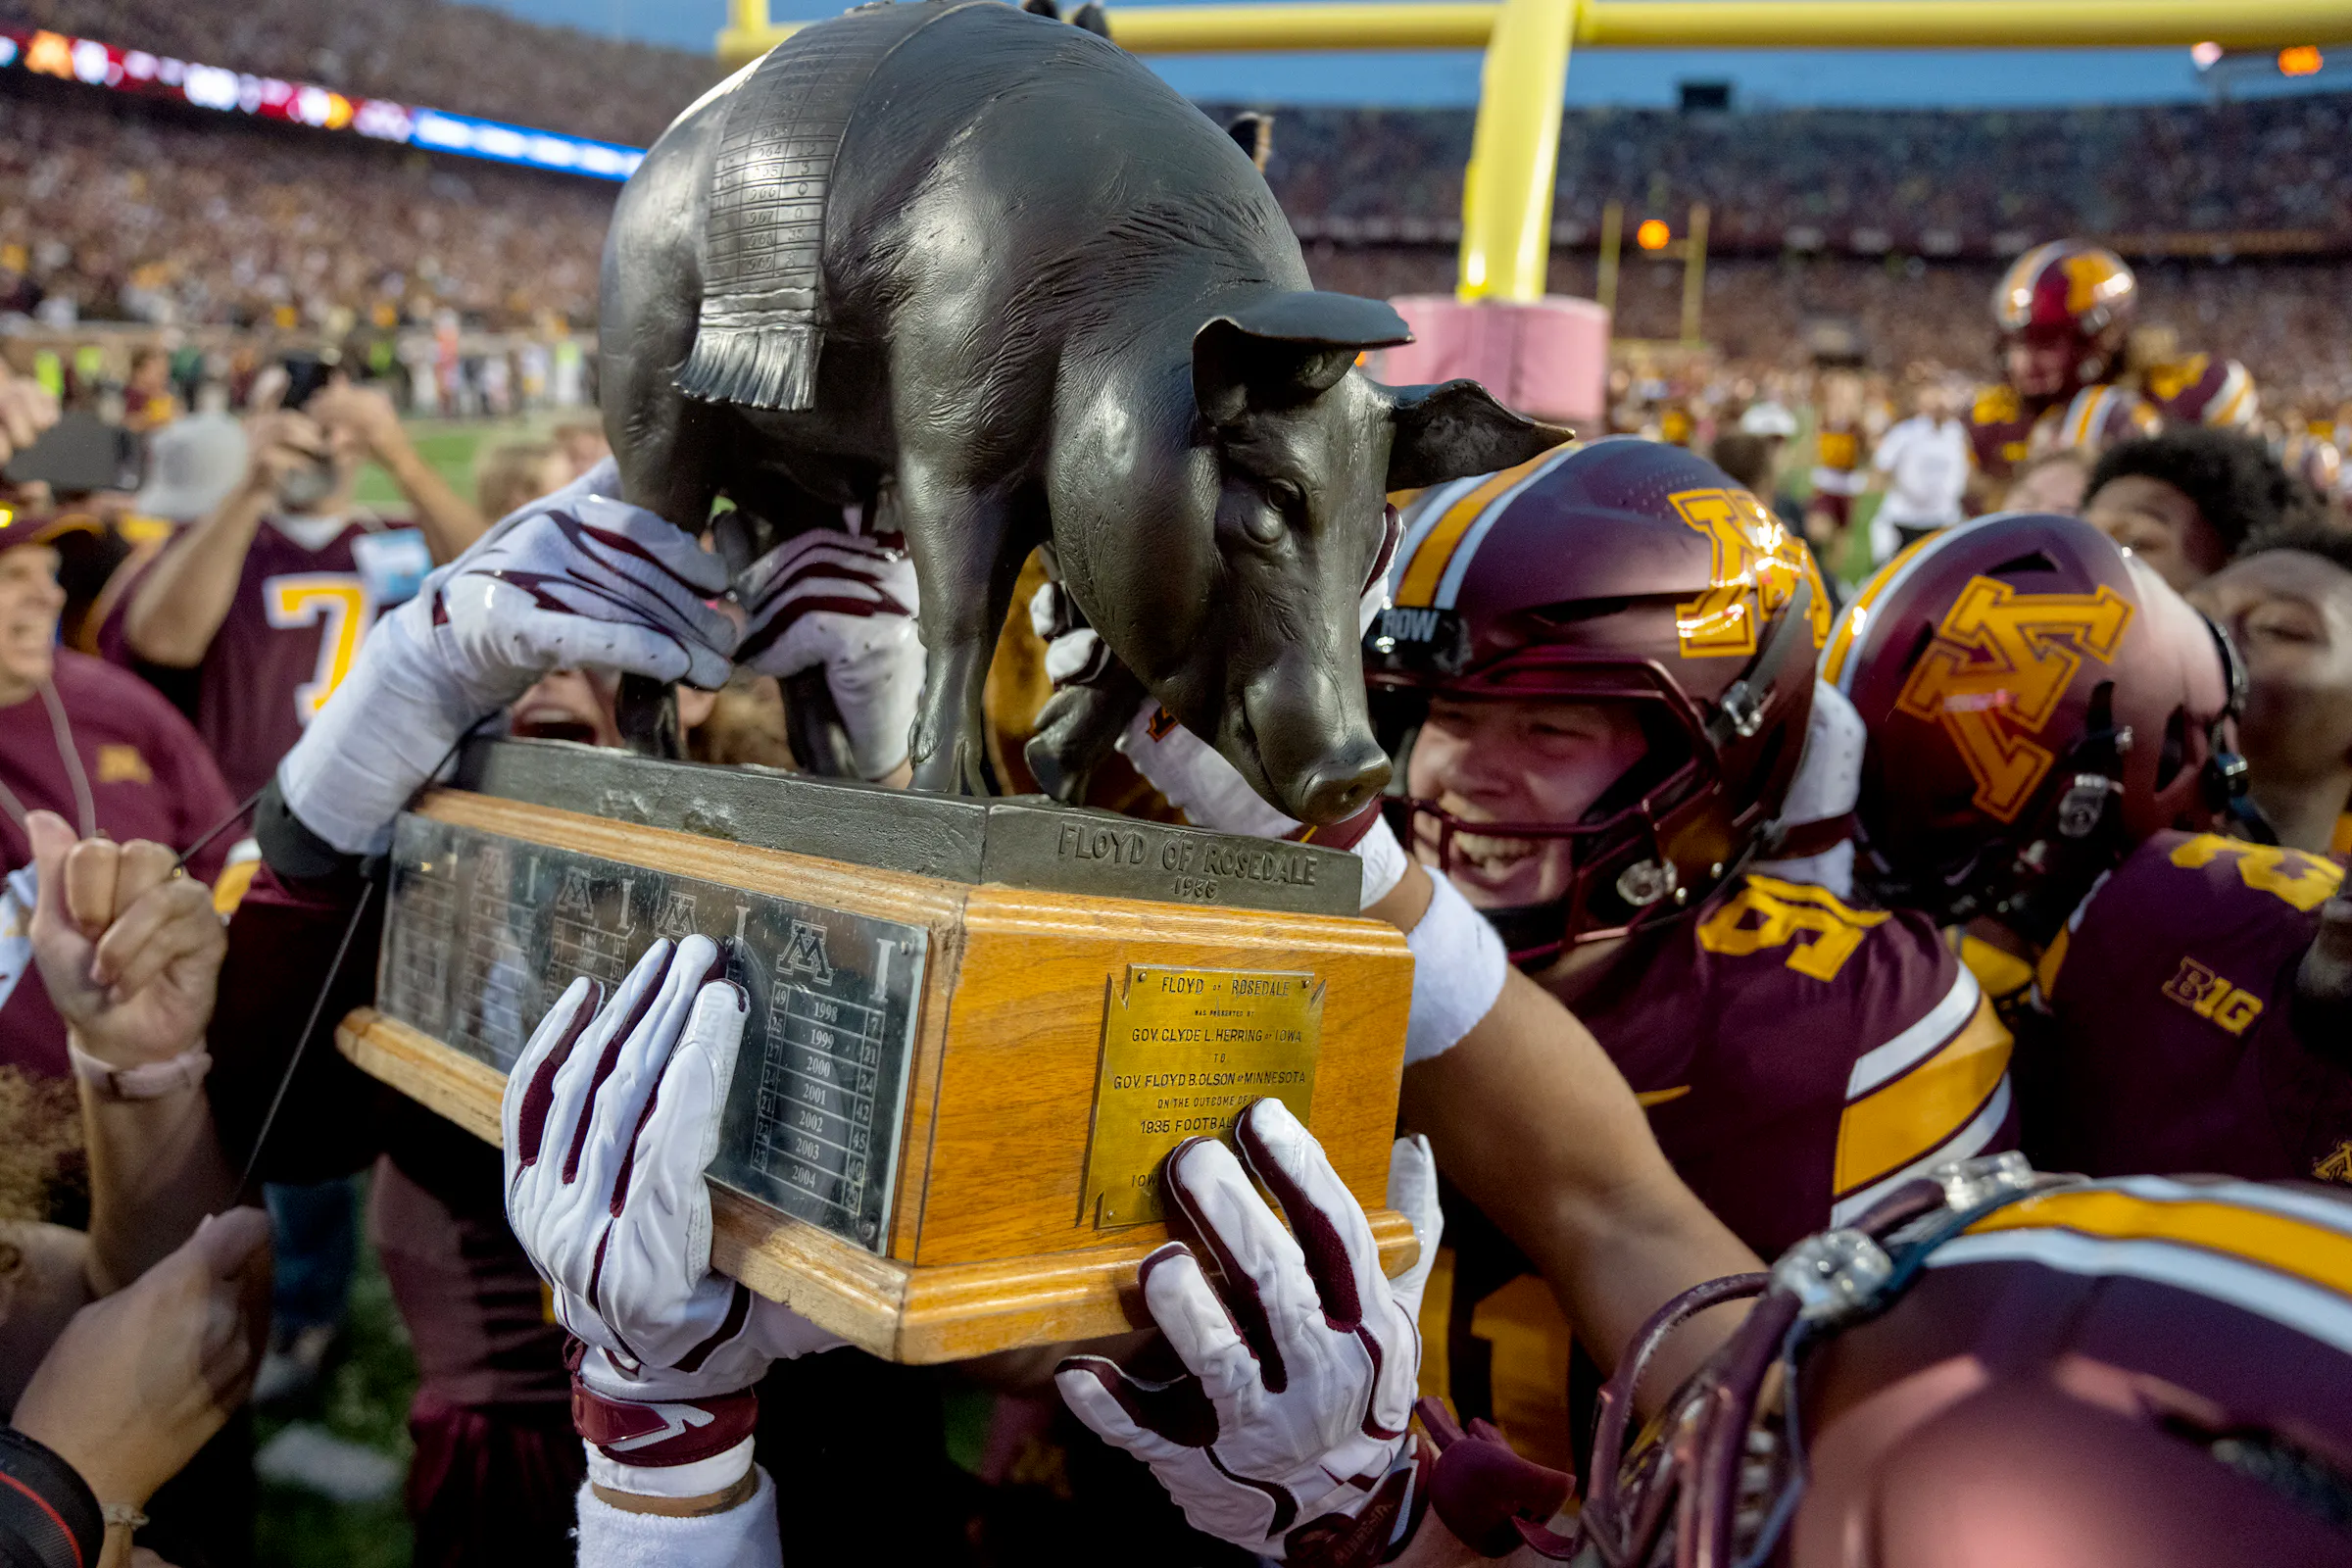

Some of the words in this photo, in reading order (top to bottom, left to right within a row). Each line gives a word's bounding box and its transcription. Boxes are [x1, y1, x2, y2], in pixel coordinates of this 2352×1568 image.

[1057, 822, 1147, 865] FLOYD
[1162, 838, 1195, 872] OF
[1203, 842, 1318, 887] ROSEDALE
[775, 918, 834, 986] M
[1160, 976, 1204, 995] FLOYD
[1231, 979, 1291, 997] ROSEDALE
[773, 989, 787, 1005] 49
[813, 1001, 839, 1023] 1998
[870, 1016, 879, 1034] 7
[809, 1028, 835, 1050] 1999
[863, 1045, 877, 1064] 21
[1132, 1028, 1158, 1042] GOV.
[1161, 1028, 1201, 1042] CLYDE
[1215, 1028, 1263, 1042] HERRING
[1275, 1028, 1302, 1043] IOWA
[767, 1042, 781, 1058] 27
[806, 1055, 831, 1078] 2000
[859, 1073, 875, 1093] 24
[1213, 1053, 1226, 1063] TO
[1113, 1074, 1141, 1090] GOV.
[1144, 1073, 1185, 1088] FLOYD
[1198, 1072, 1235, 1087] OLSON
[1244, 1070, 1306, 1085] MINNESOTA
[803, 1082, 826, 1106] 2001
[856, 1102, 870, 1122] 42
[1157, 1099, 1169, 1109] ON
[1171, 1098, 1190, 1108] THE
[1193, 1096, 1236, 1108] OUTCOME
[1237, 1095, 1249, 1105] OF
[760, 1095, 772, 1113] 21
[799, 1109, 824, 1134] 2002
[852, 1130, 867, 1151] 45
[1140, 1118, 1171, 1134] 1935
[795, 1137, 820, 1161] 2003
[791, 1164, 817, 1189] 2004
[1131, 1173, 1157, 1188] IOW
